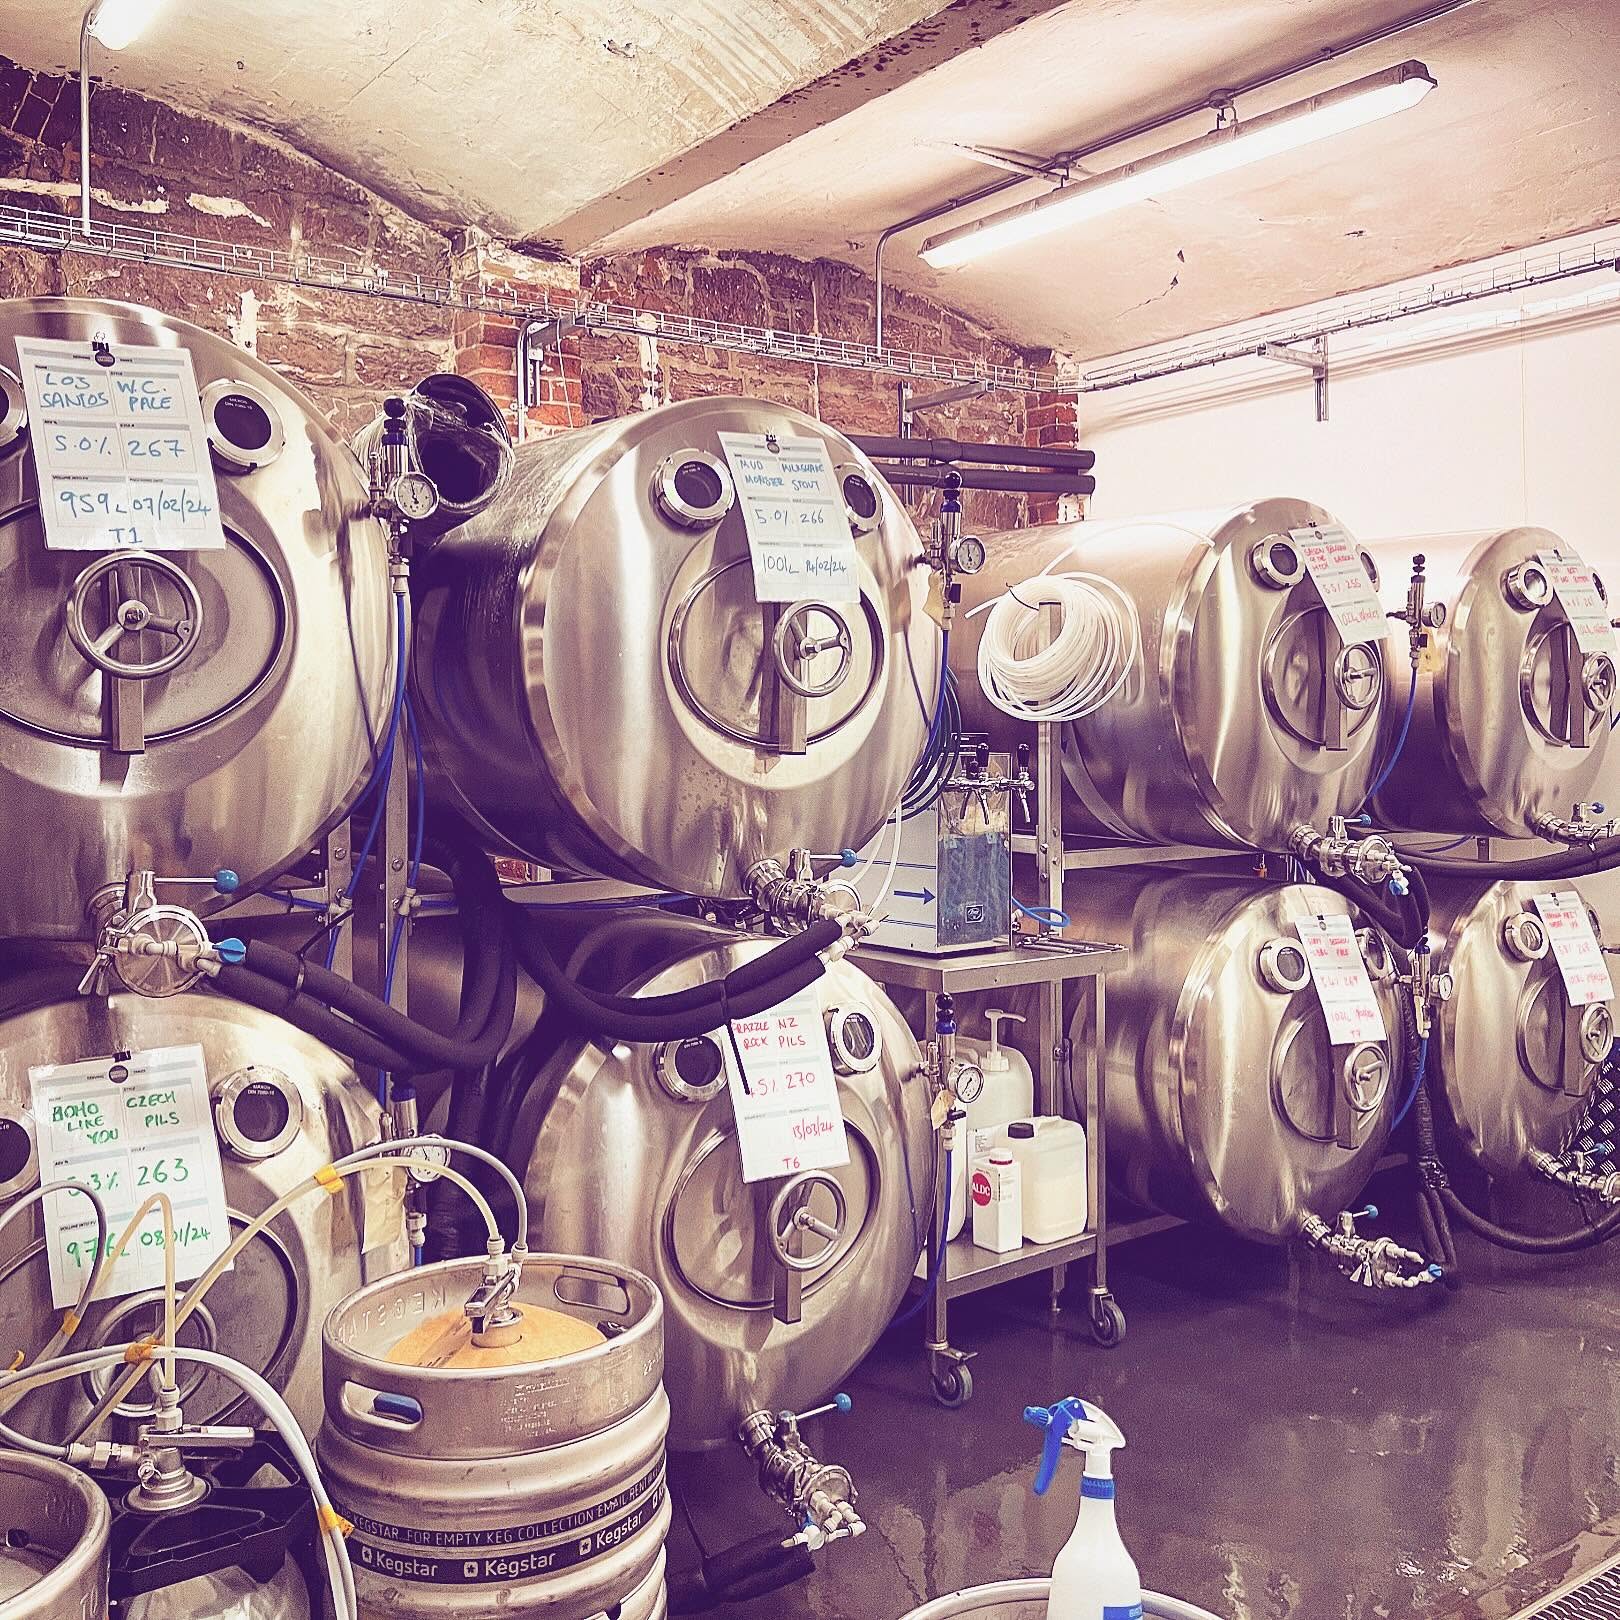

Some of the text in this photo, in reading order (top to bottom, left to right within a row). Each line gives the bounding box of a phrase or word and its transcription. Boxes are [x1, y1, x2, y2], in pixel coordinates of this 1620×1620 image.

[46, 373, 91, 391] LOS
[117, 379, 167, 394] W.C.
[40, 392, 109, 410] SANTOS
[128, 396, 173, 412] PALE
[127, 439, 186, 459] 267
[740, 459, 764, 471] MUD
[132, 488, 212, 522] 07/02/24
[800, 506, 824, 524] 266
[109, 527, 144, 545] T1
[778, 1017, 799, 1029] NZ
[743, 1035, 806, 1050] ROCK PILS
[785, 1071, 816, 1089] 270
[126, 1090, 177, 1109] CZECH
[52, 1101, 99, 1123] BOHO
[144, 1111, 180, 1128] PILS
[67, 1114, 105, 1132] LIKE
[87, 1128, 119, 1145] YOU
[783, 1156, 801, 1169] T6
[136, 1157, 190, 1187] 263
[436, 1532, 482, 1547] EMPTY
[486, 1528, 513, 1545] KEG
[518, 1509, 594, 1540] COLLECTION
[597, 1494, 627, 1518] EMAIL
[376, 1550, 439, 1576] Kegstar
[485, 1550, 557, 1577] Kegstar
[596, 1510, 643, 1549] Kegstar
